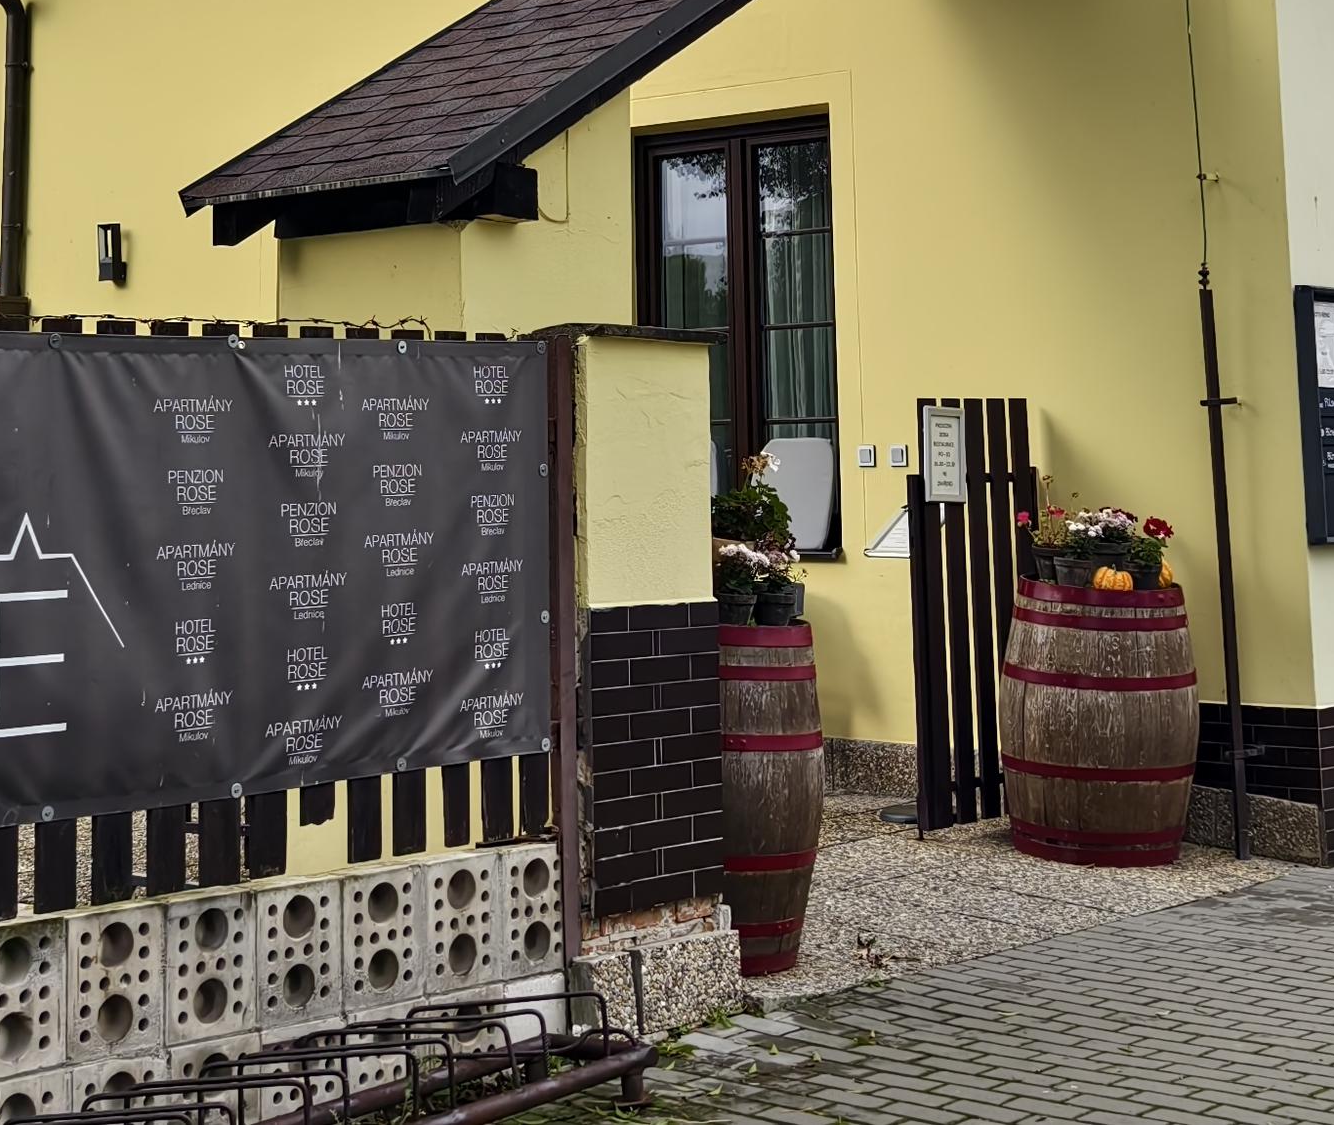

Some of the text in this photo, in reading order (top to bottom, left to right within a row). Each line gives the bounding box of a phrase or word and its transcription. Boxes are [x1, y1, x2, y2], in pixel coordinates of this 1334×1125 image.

[285, 365, 324, 378] HOTEL
[474, 366, 509, 378] HOTEL
[287, 380, 324, 394] ROSE
[475, 380, 508, 396] ROSE
[154, 395, 232, 412] APARTMÁNY
[362, 395, 429, 412] APARTMÁNY
[176, 415, 215, 430] ROSE
[379, 413, 413, 427] ROSE
[268, 434, 345, 447] APARTMÁNY
[461, 427, 521, 443] APARTMÁNY
[290, 449, 329, 464] ROSE
[478, 444, 507, 458] ROSE
[168, 469, 223, 484] PENZION
[373, 464, 422, 478] PENZION
[177, 485, 216, 501] ROSE
[380, 478, 415, 494] ROSE
[471, 494, 514, 508] PENZION
[281, 502, 336, 517] PENZION
[477, 509, 509, 526] ROSE
[290, 517, 329, 533] ROSE
[365, 529, 433, 548] APARTMÁNY
[157, 540, 234, 560] APARTMÁNY
[382, 548, 418, 563] ROSE
[177, 559, 216, 576] ROSE
[462, 558, 523, 576] APARTMÁNY
[270, 570, 347, 590] APARTMÁNY
[478, 575, 508, 590] ROSE
[290, 589, 328, 610] ROSE
[382, 602, 417, 617] HOTEL
[176, 619, 216, 635] HOTEL
[383, 617, 416, 634] ROSE
[177, 635, 214, 652] ROSE
[475, 628, 510, 643] HOTEL
[287, 646, 328, 662] HOTEL
[475, 642, 509, 661] ROSE
[288, 662, 326, 680] ROSE
[362, 667, 433, 689] APARTMÁNY
[155, 688, 232, 712] APARTMÁNY
[380, 686, 416, 704] ROSE
[460, 692, 523, 712] APARTMÁNY
[175, 709, 213, 728] ROSE
[474, 709, 509, 726] ROSE
[266, 715, 342, 737] APARTMÁNY
[286, 733, 322, 752] ROSE
